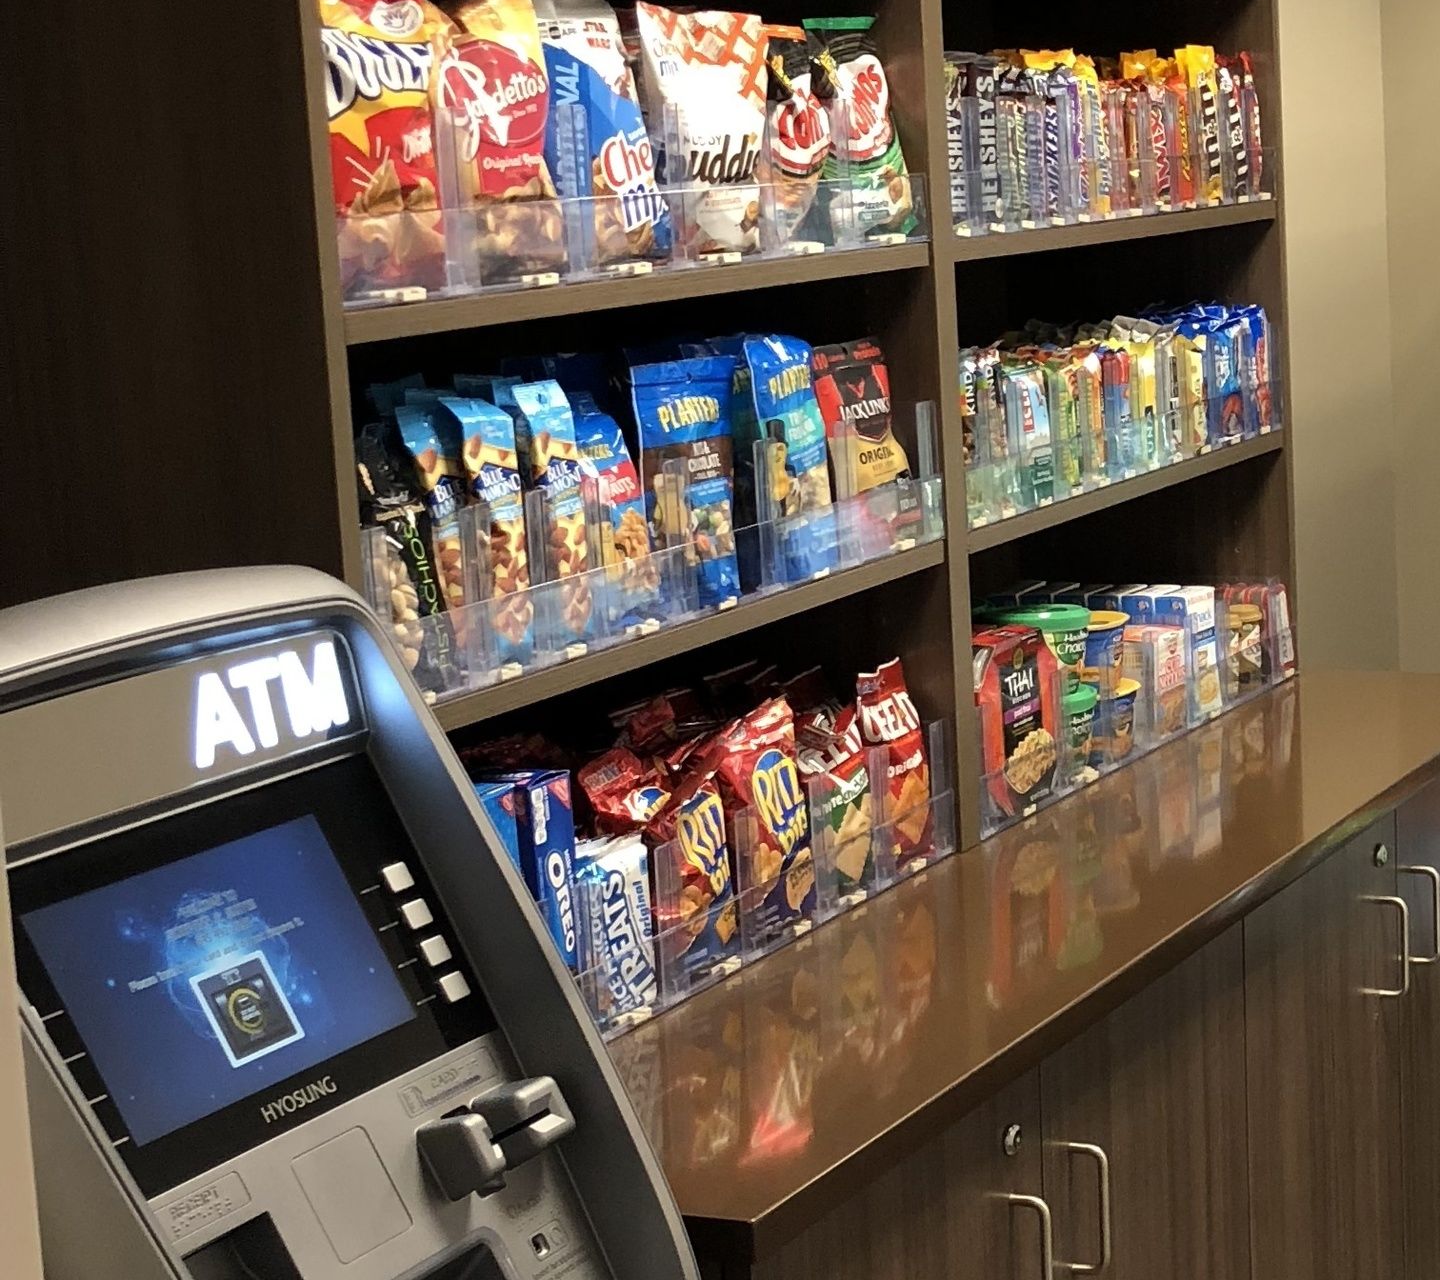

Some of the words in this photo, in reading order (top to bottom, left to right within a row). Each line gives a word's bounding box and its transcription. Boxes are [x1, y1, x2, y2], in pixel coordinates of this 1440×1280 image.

[437, 47, 548, 163] Gardetto's
[483, 154, 522, 172] Original
[602, 134, 653, 189] Che
[946, 96, 967, 213] HERSHEY'S
[975, 75, 998, 213] HERSHEY'S
[840, 402, 865, 421] JACK
[964, 369, 977, 417] KIND
[480, 467, 504, 488] BLUE
[547, 460, 570, 482] BLUE
[194, 640, 350, 769] ATM
[1004, 667, 1034, 697] THAI
[753, 756, 805, 835] RITZ
[677, 794, 726, 877] RITZ
[546, 849, 576, 954] OREO
[632, 880, 653, 938] Original
[602, 869, 656, 1009] TREATS
[260, 1075, 337, 1123] HYOSUNG
